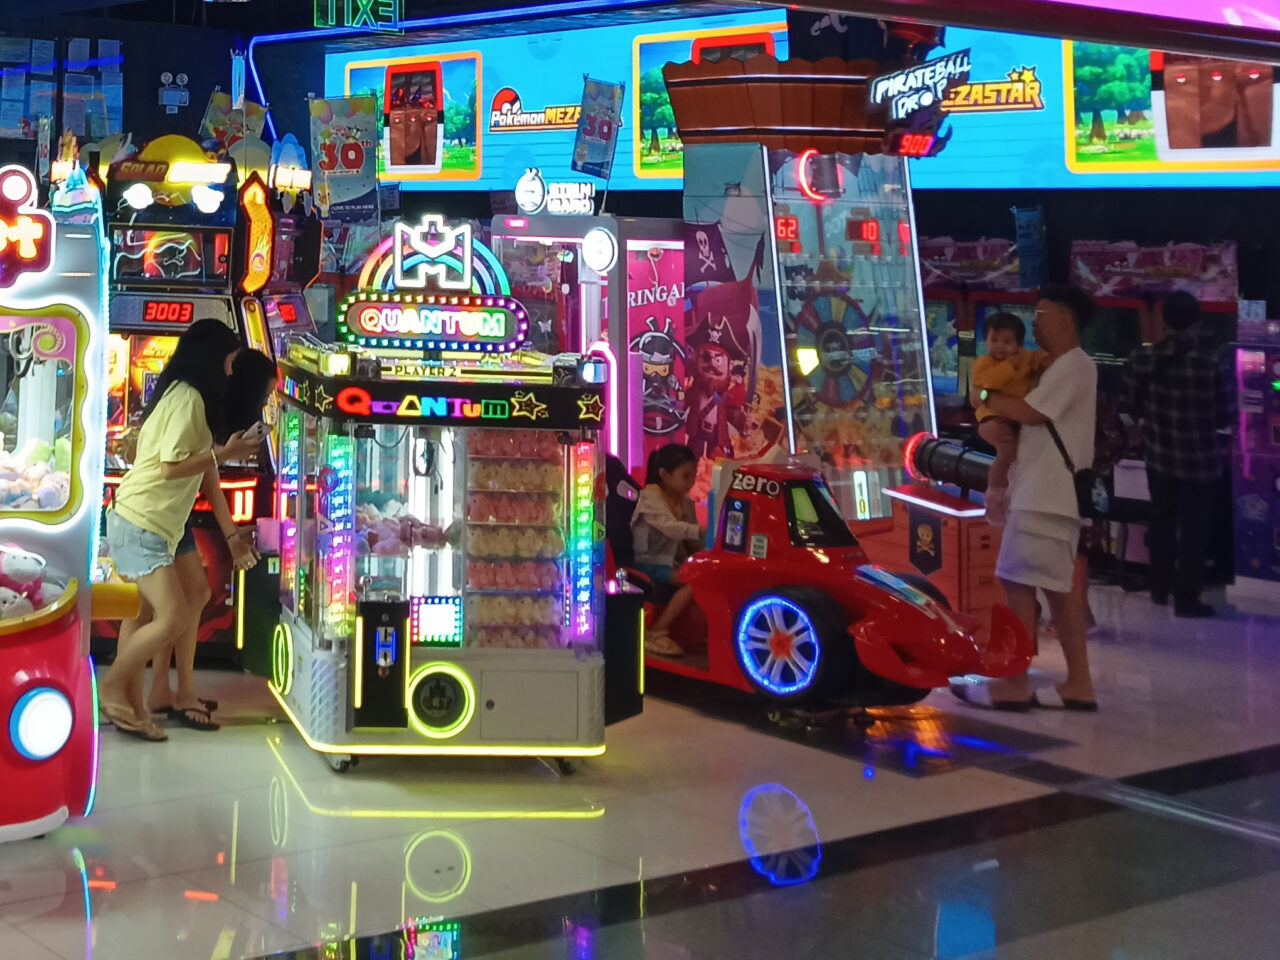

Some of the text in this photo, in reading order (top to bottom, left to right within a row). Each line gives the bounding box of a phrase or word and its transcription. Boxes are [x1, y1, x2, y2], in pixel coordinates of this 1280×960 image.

[873, 55, 972, 104] PIRATEBALL
[490, 109, 545, 127] Pokémon
[900, 134, 934, 154] 900
[776, 219, 797, 238] 62
[145, 302, 192, 322] 3003
[359, 305, 506, 337] QUANTUM
[394, 366, 457, 378] PLAYER 2
[732, 471, 780, 496] zero
